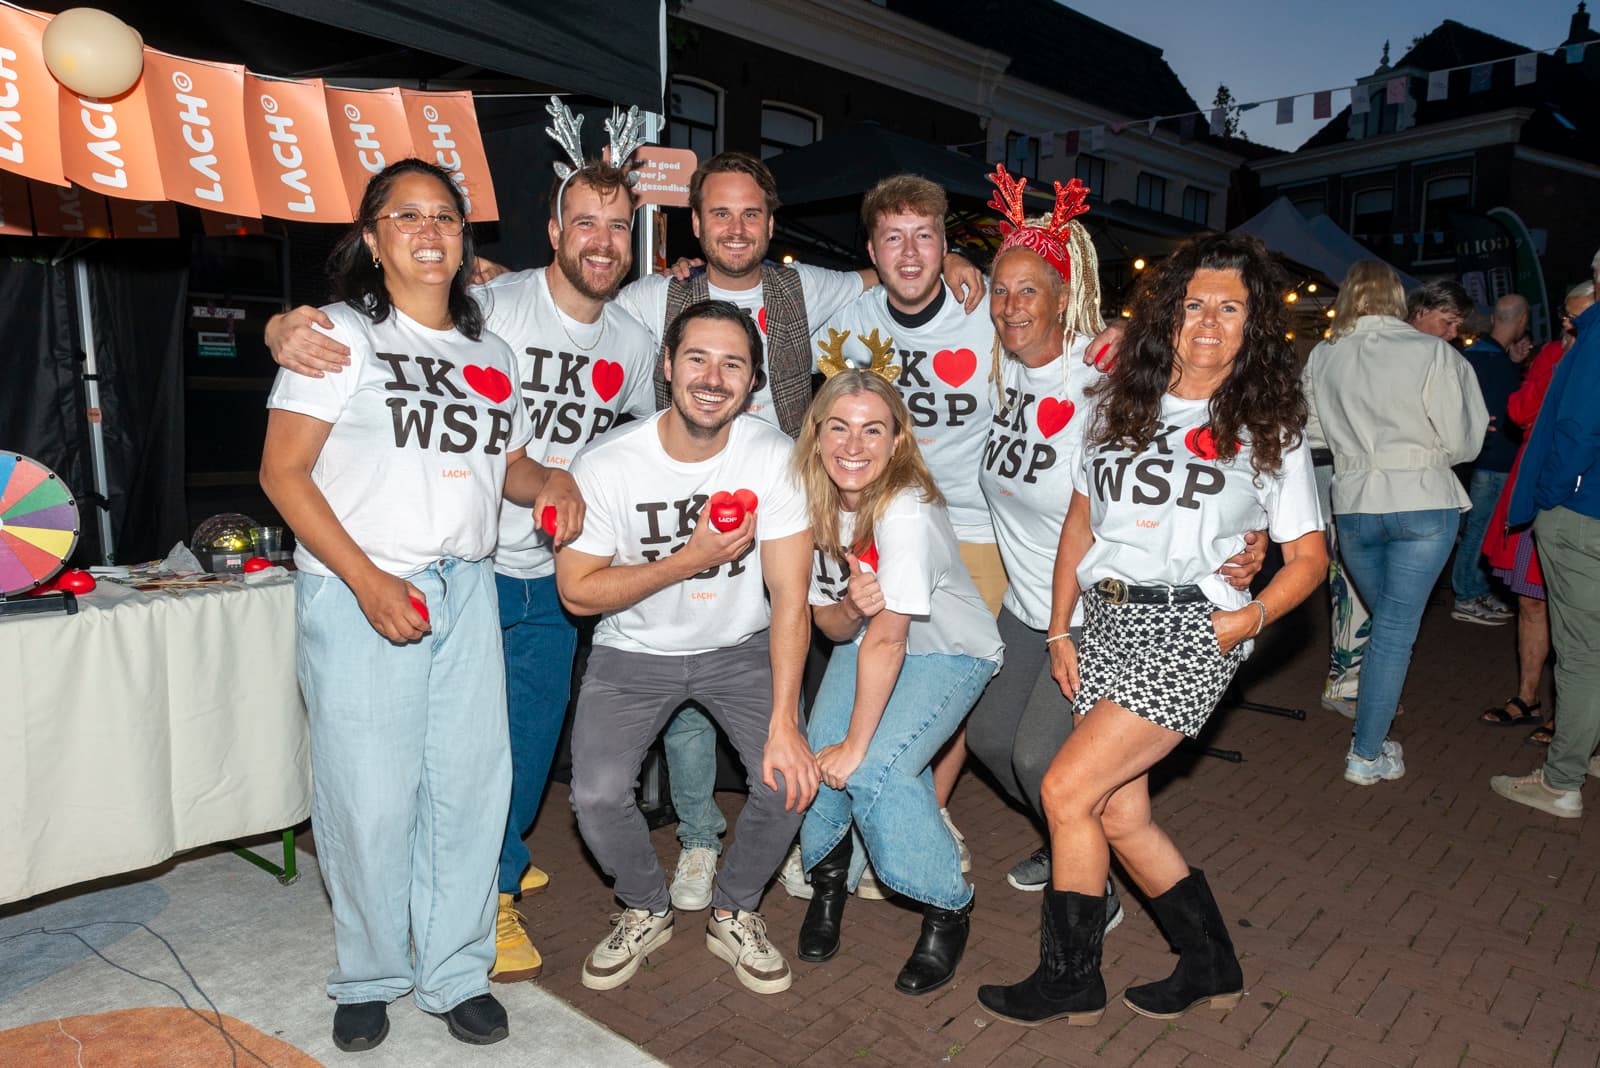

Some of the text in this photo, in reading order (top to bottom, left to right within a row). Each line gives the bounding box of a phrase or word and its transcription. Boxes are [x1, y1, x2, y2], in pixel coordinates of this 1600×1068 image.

[375, 352, 468, 400] IK
[521, 347, 590, 397] IK
[385, 397, 512, 456] WSP
[900, 391, 978, 428] SP
[993, 387, 1035, 434] IK
[1093, 457, 1226, 510] WSP
